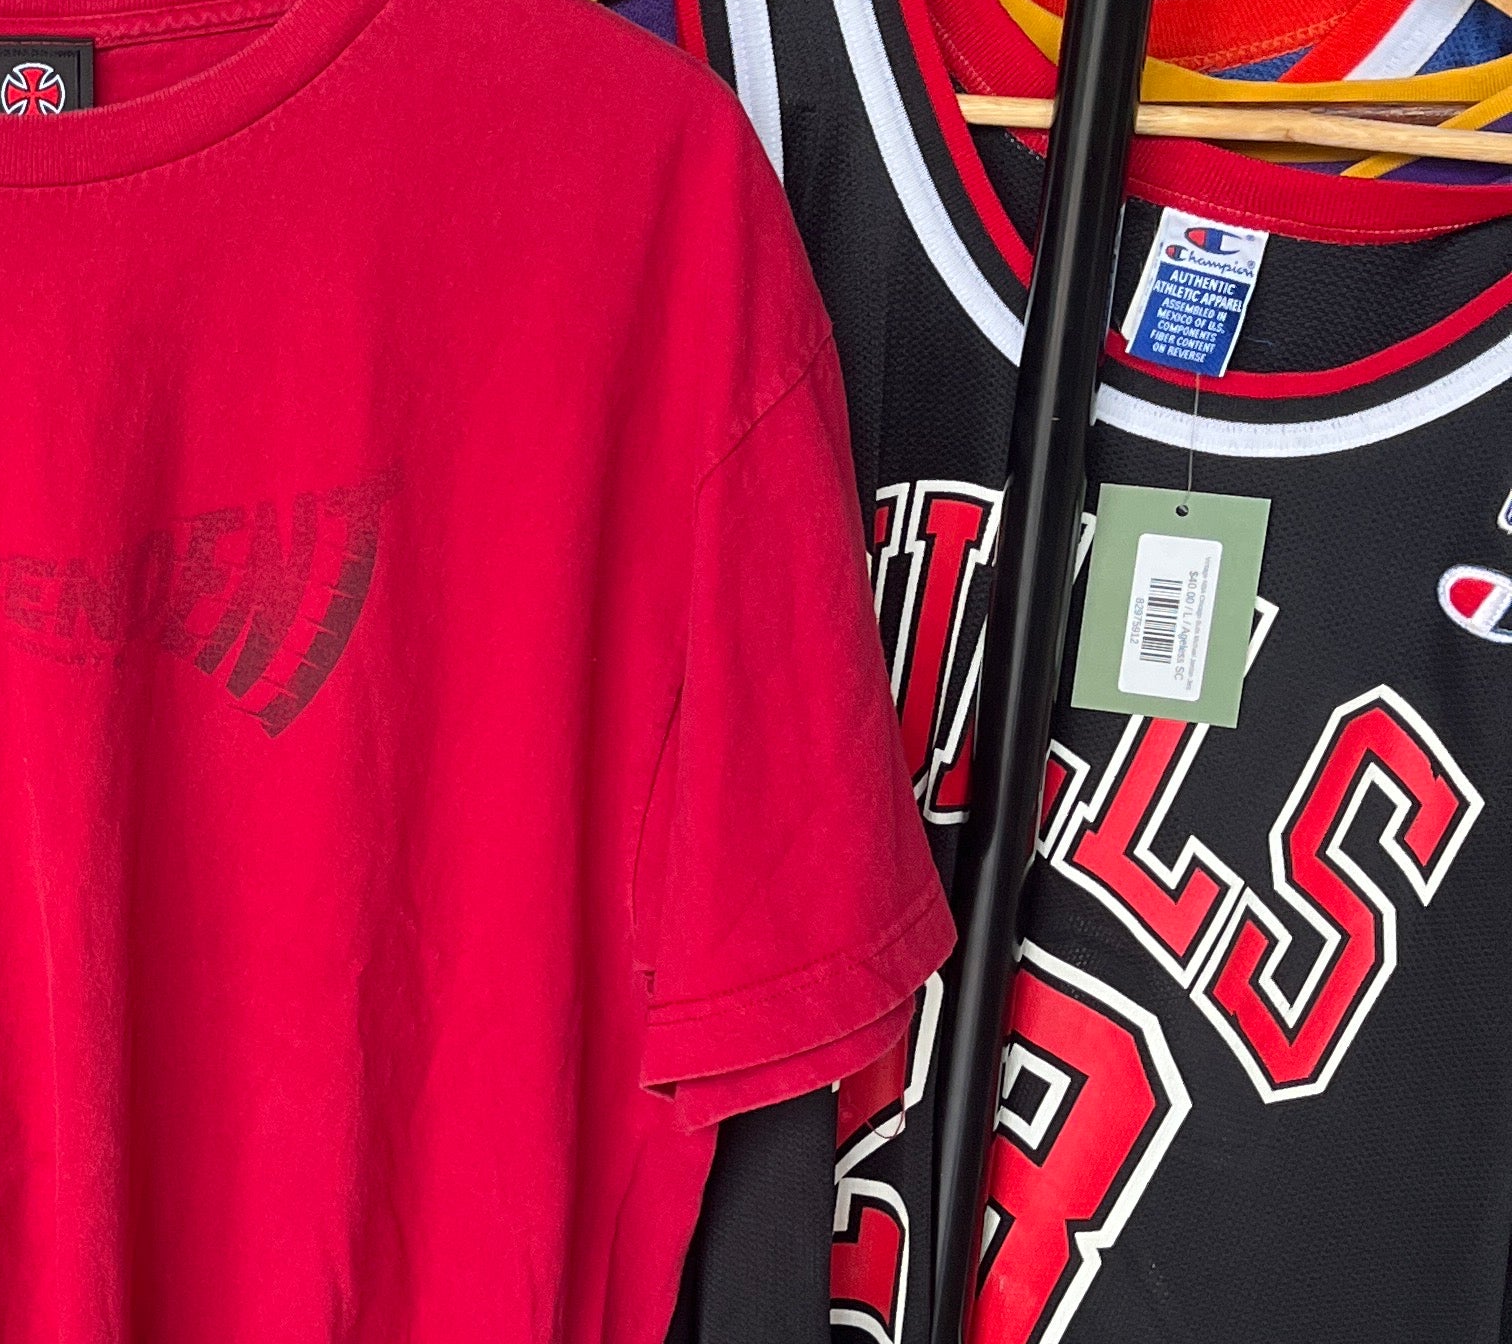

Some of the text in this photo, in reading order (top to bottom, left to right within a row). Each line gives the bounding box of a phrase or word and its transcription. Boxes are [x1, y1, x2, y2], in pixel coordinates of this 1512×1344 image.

[1165, 244, 1255, 278] Champion
[1170, 269, 1237, 296] AUTHENTIC
[1153, 279, 1243, 313] ATHLETIC APPAREL
[1156, 307, 1226, 335] MEXICO OF U.S.
[1161, 297, 1228, 322] ASSEMBLED IN
[1150, 329, 1216, 353] FIBER CONTENT
[1157, 319, 1218, 343] COMPONENTS
[1152, 342, 1207, 363] ON REVERSE
[1186, 570, 1199, 604] $40.00
[1174, 665, 1185, 681] SC
